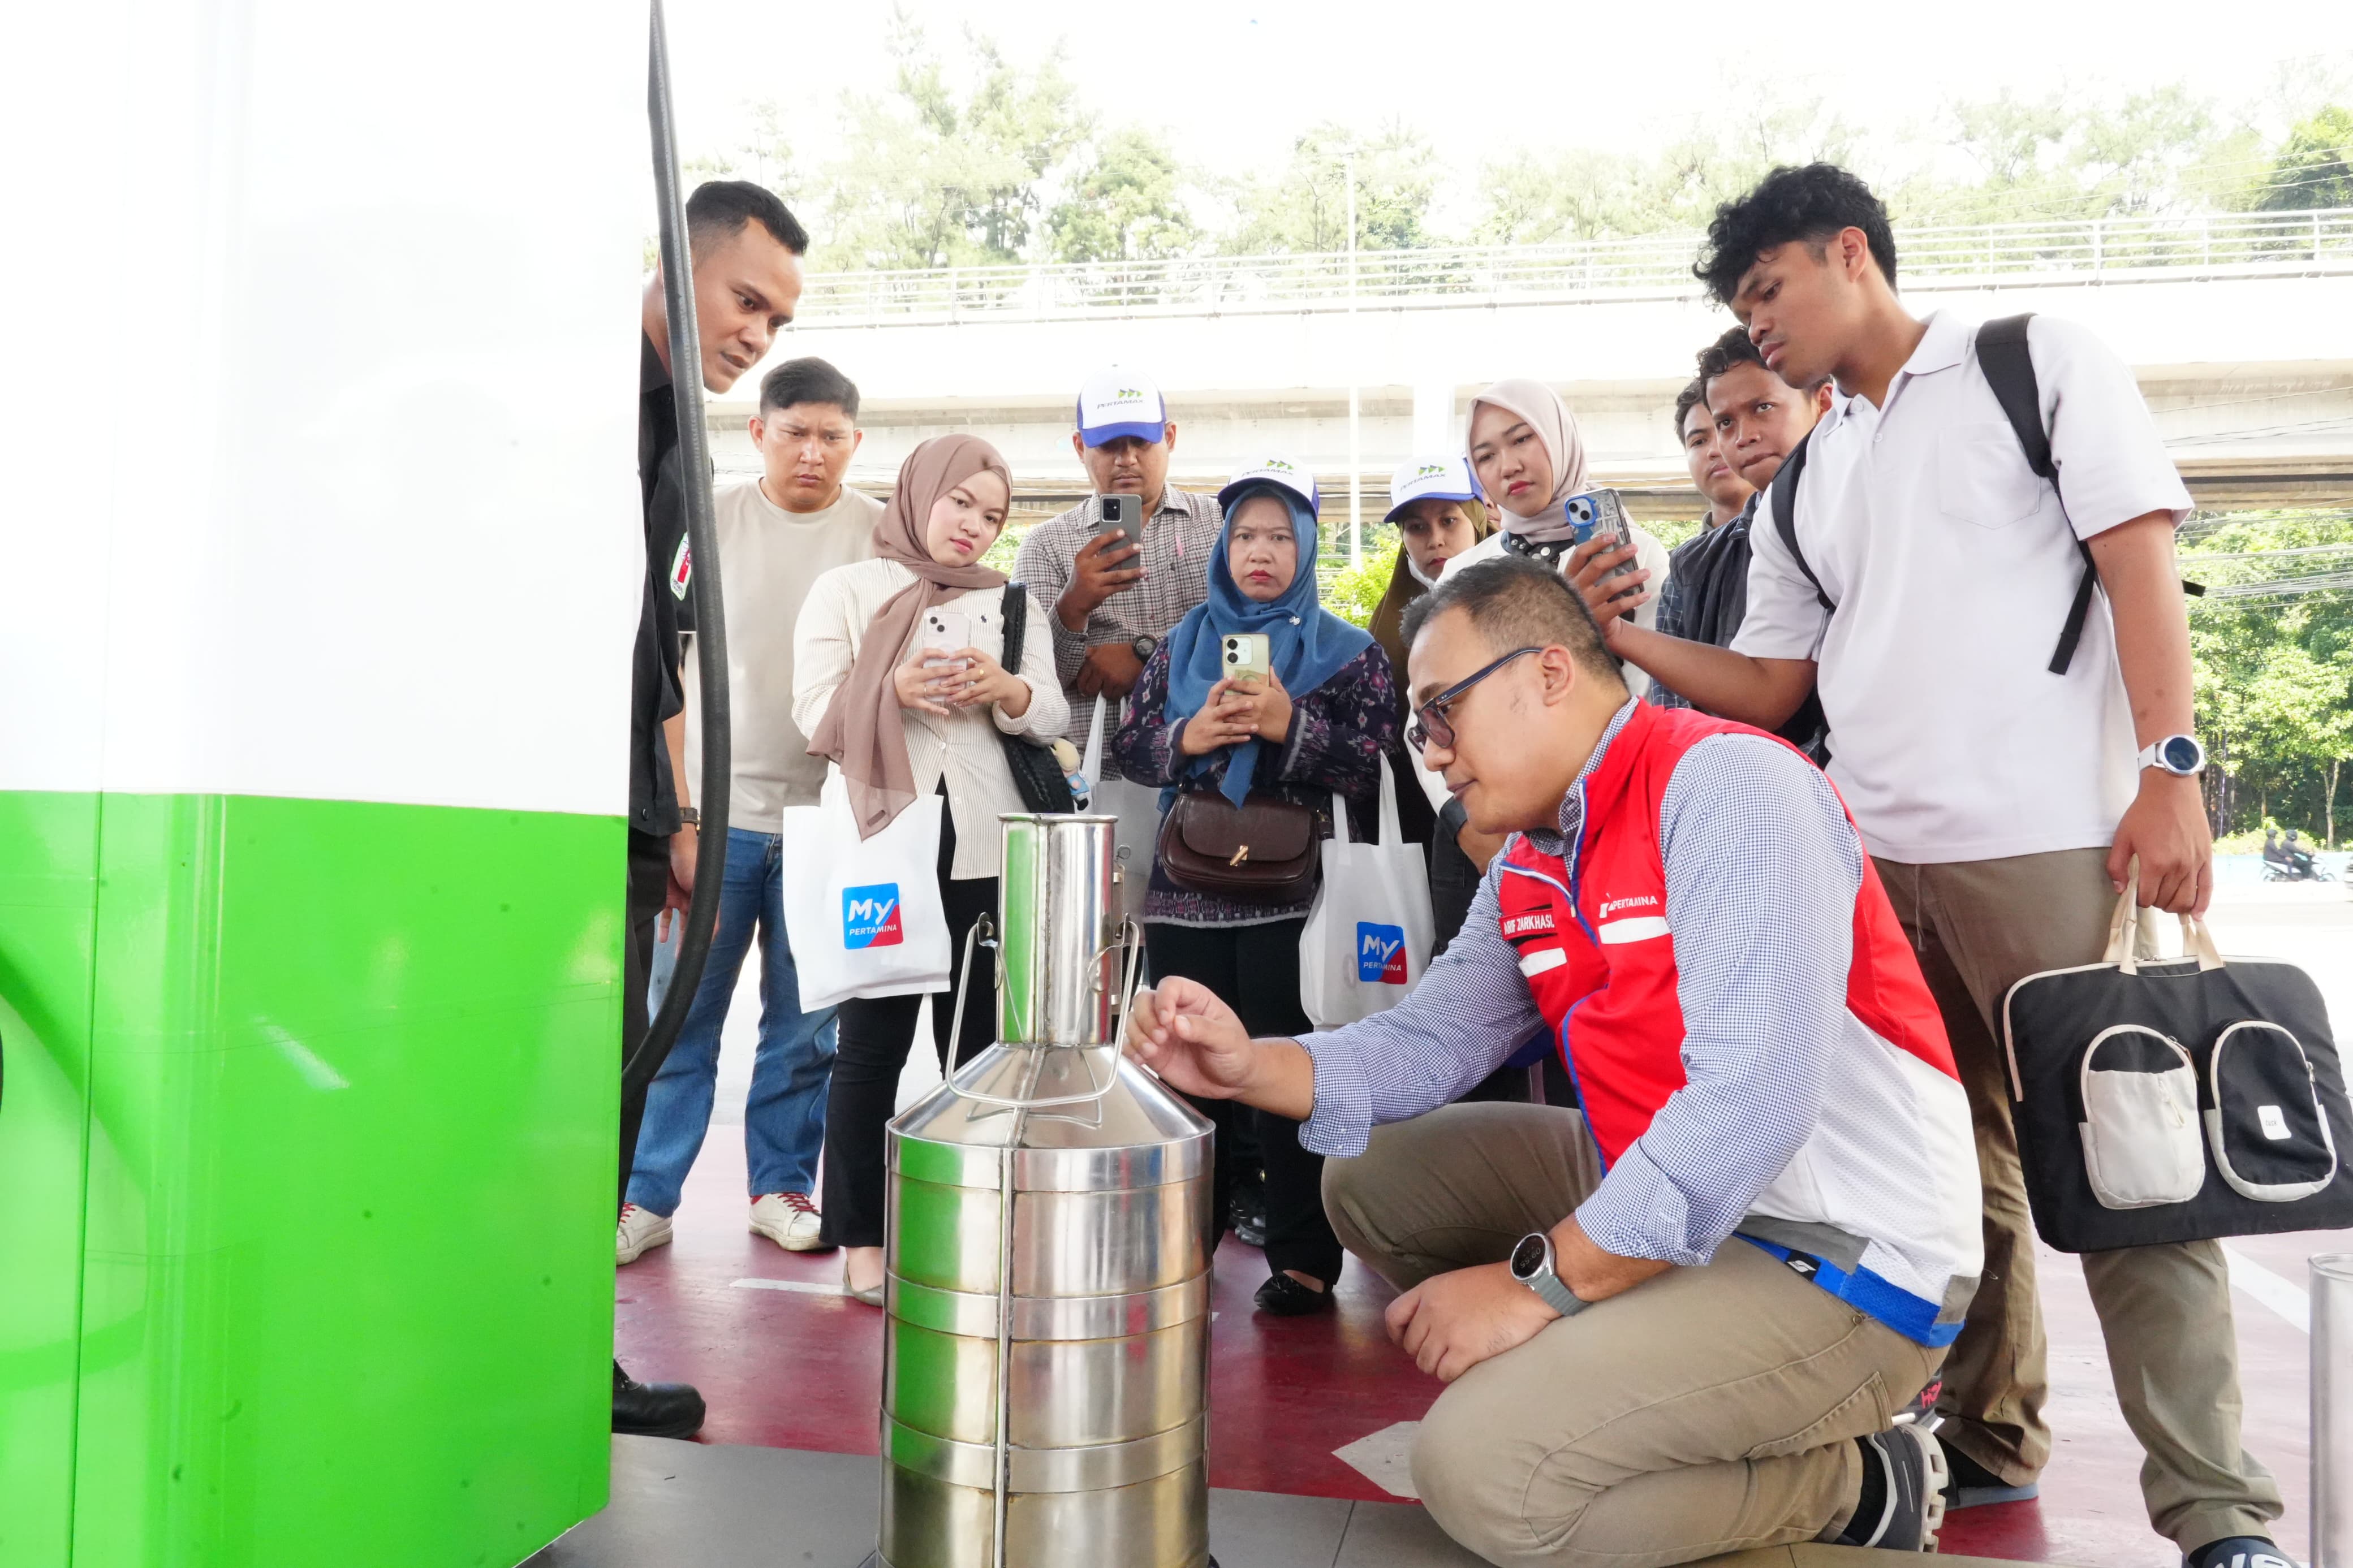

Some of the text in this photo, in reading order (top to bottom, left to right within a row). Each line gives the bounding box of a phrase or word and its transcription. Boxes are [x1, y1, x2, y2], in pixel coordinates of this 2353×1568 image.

[1097, 399, 1143, 409] PERTAMAX
[848, 898, 895, 925] My
[849, 924, 897, 936] PERTAMINA
[1362, 935, 1400, 962] My
